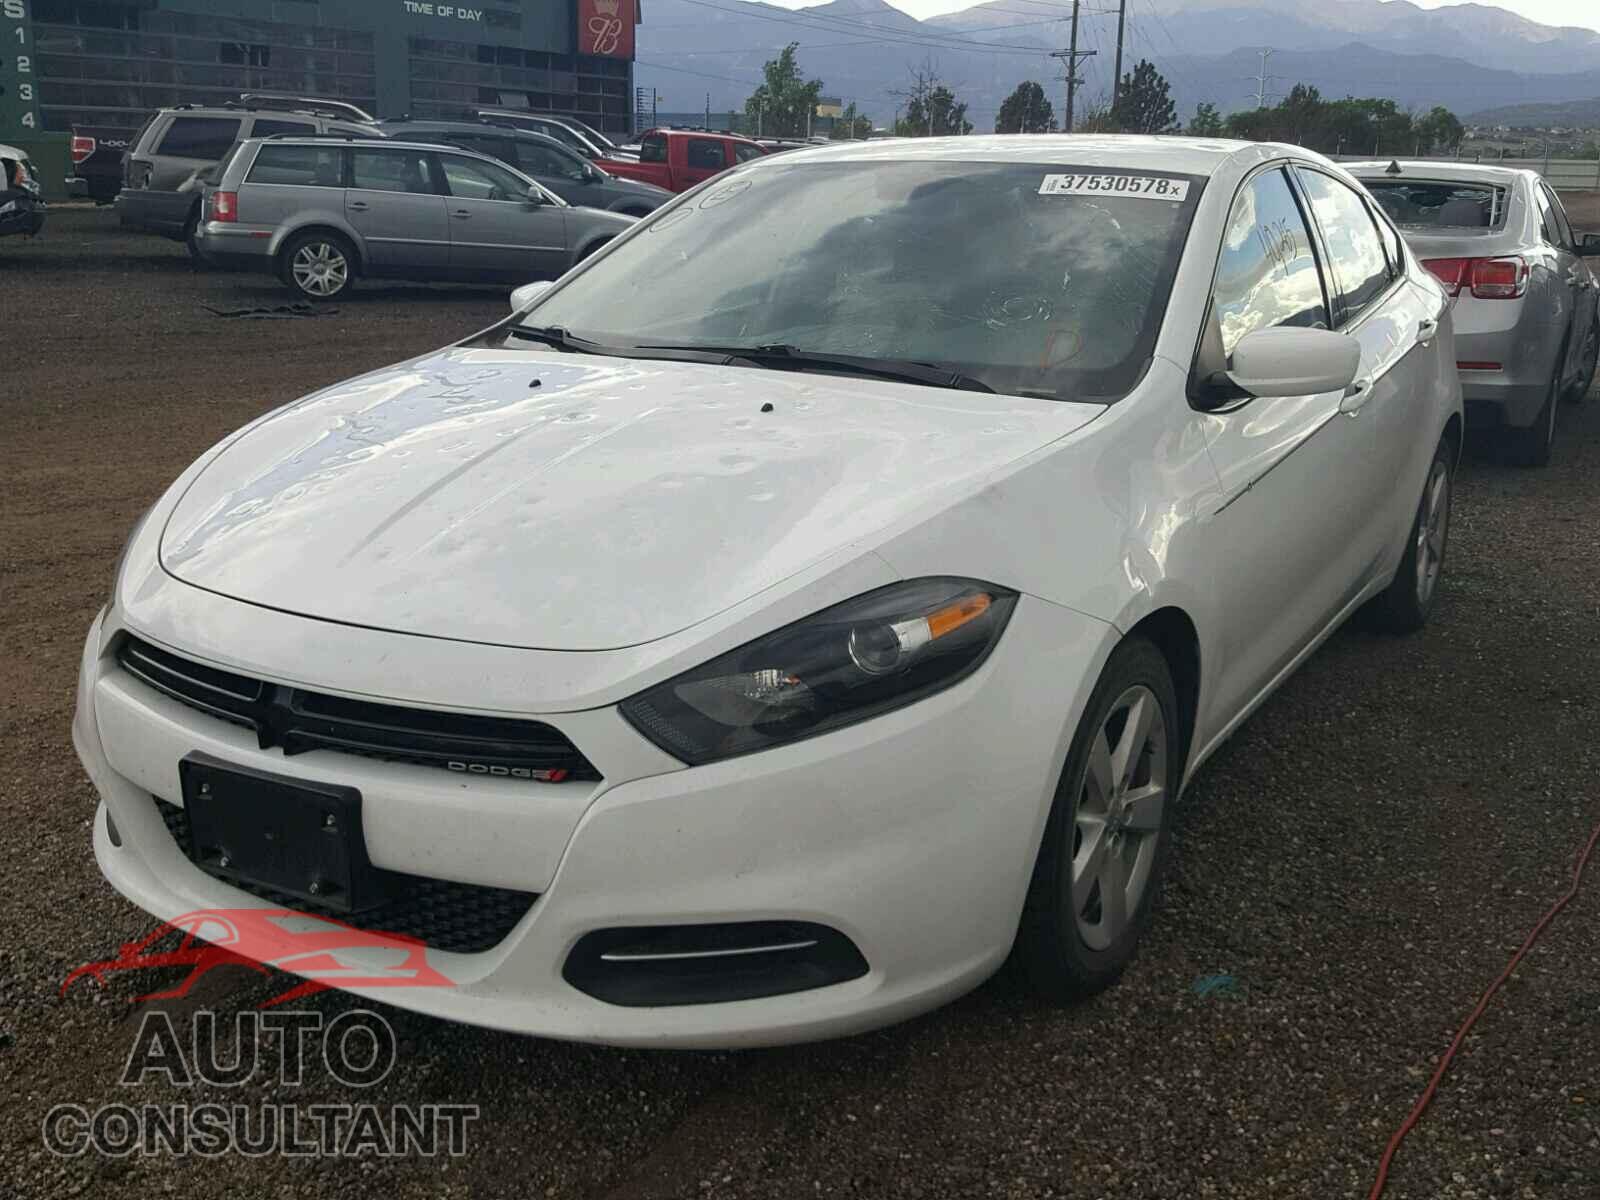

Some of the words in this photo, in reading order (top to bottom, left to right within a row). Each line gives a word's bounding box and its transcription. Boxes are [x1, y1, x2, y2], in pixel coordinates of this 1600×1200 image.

[404, 1, 433, 15] TIME
[437, 5, 454, 17] OF
[457, 8, 482, 21] DAY
[15, 26, 25, 44] 1
[17, 55, 31, 73] 2
[19, 83, 33, 101] 3
[21, 111, 35, 129] 4
[447, 761, 552, 780] DODGE
